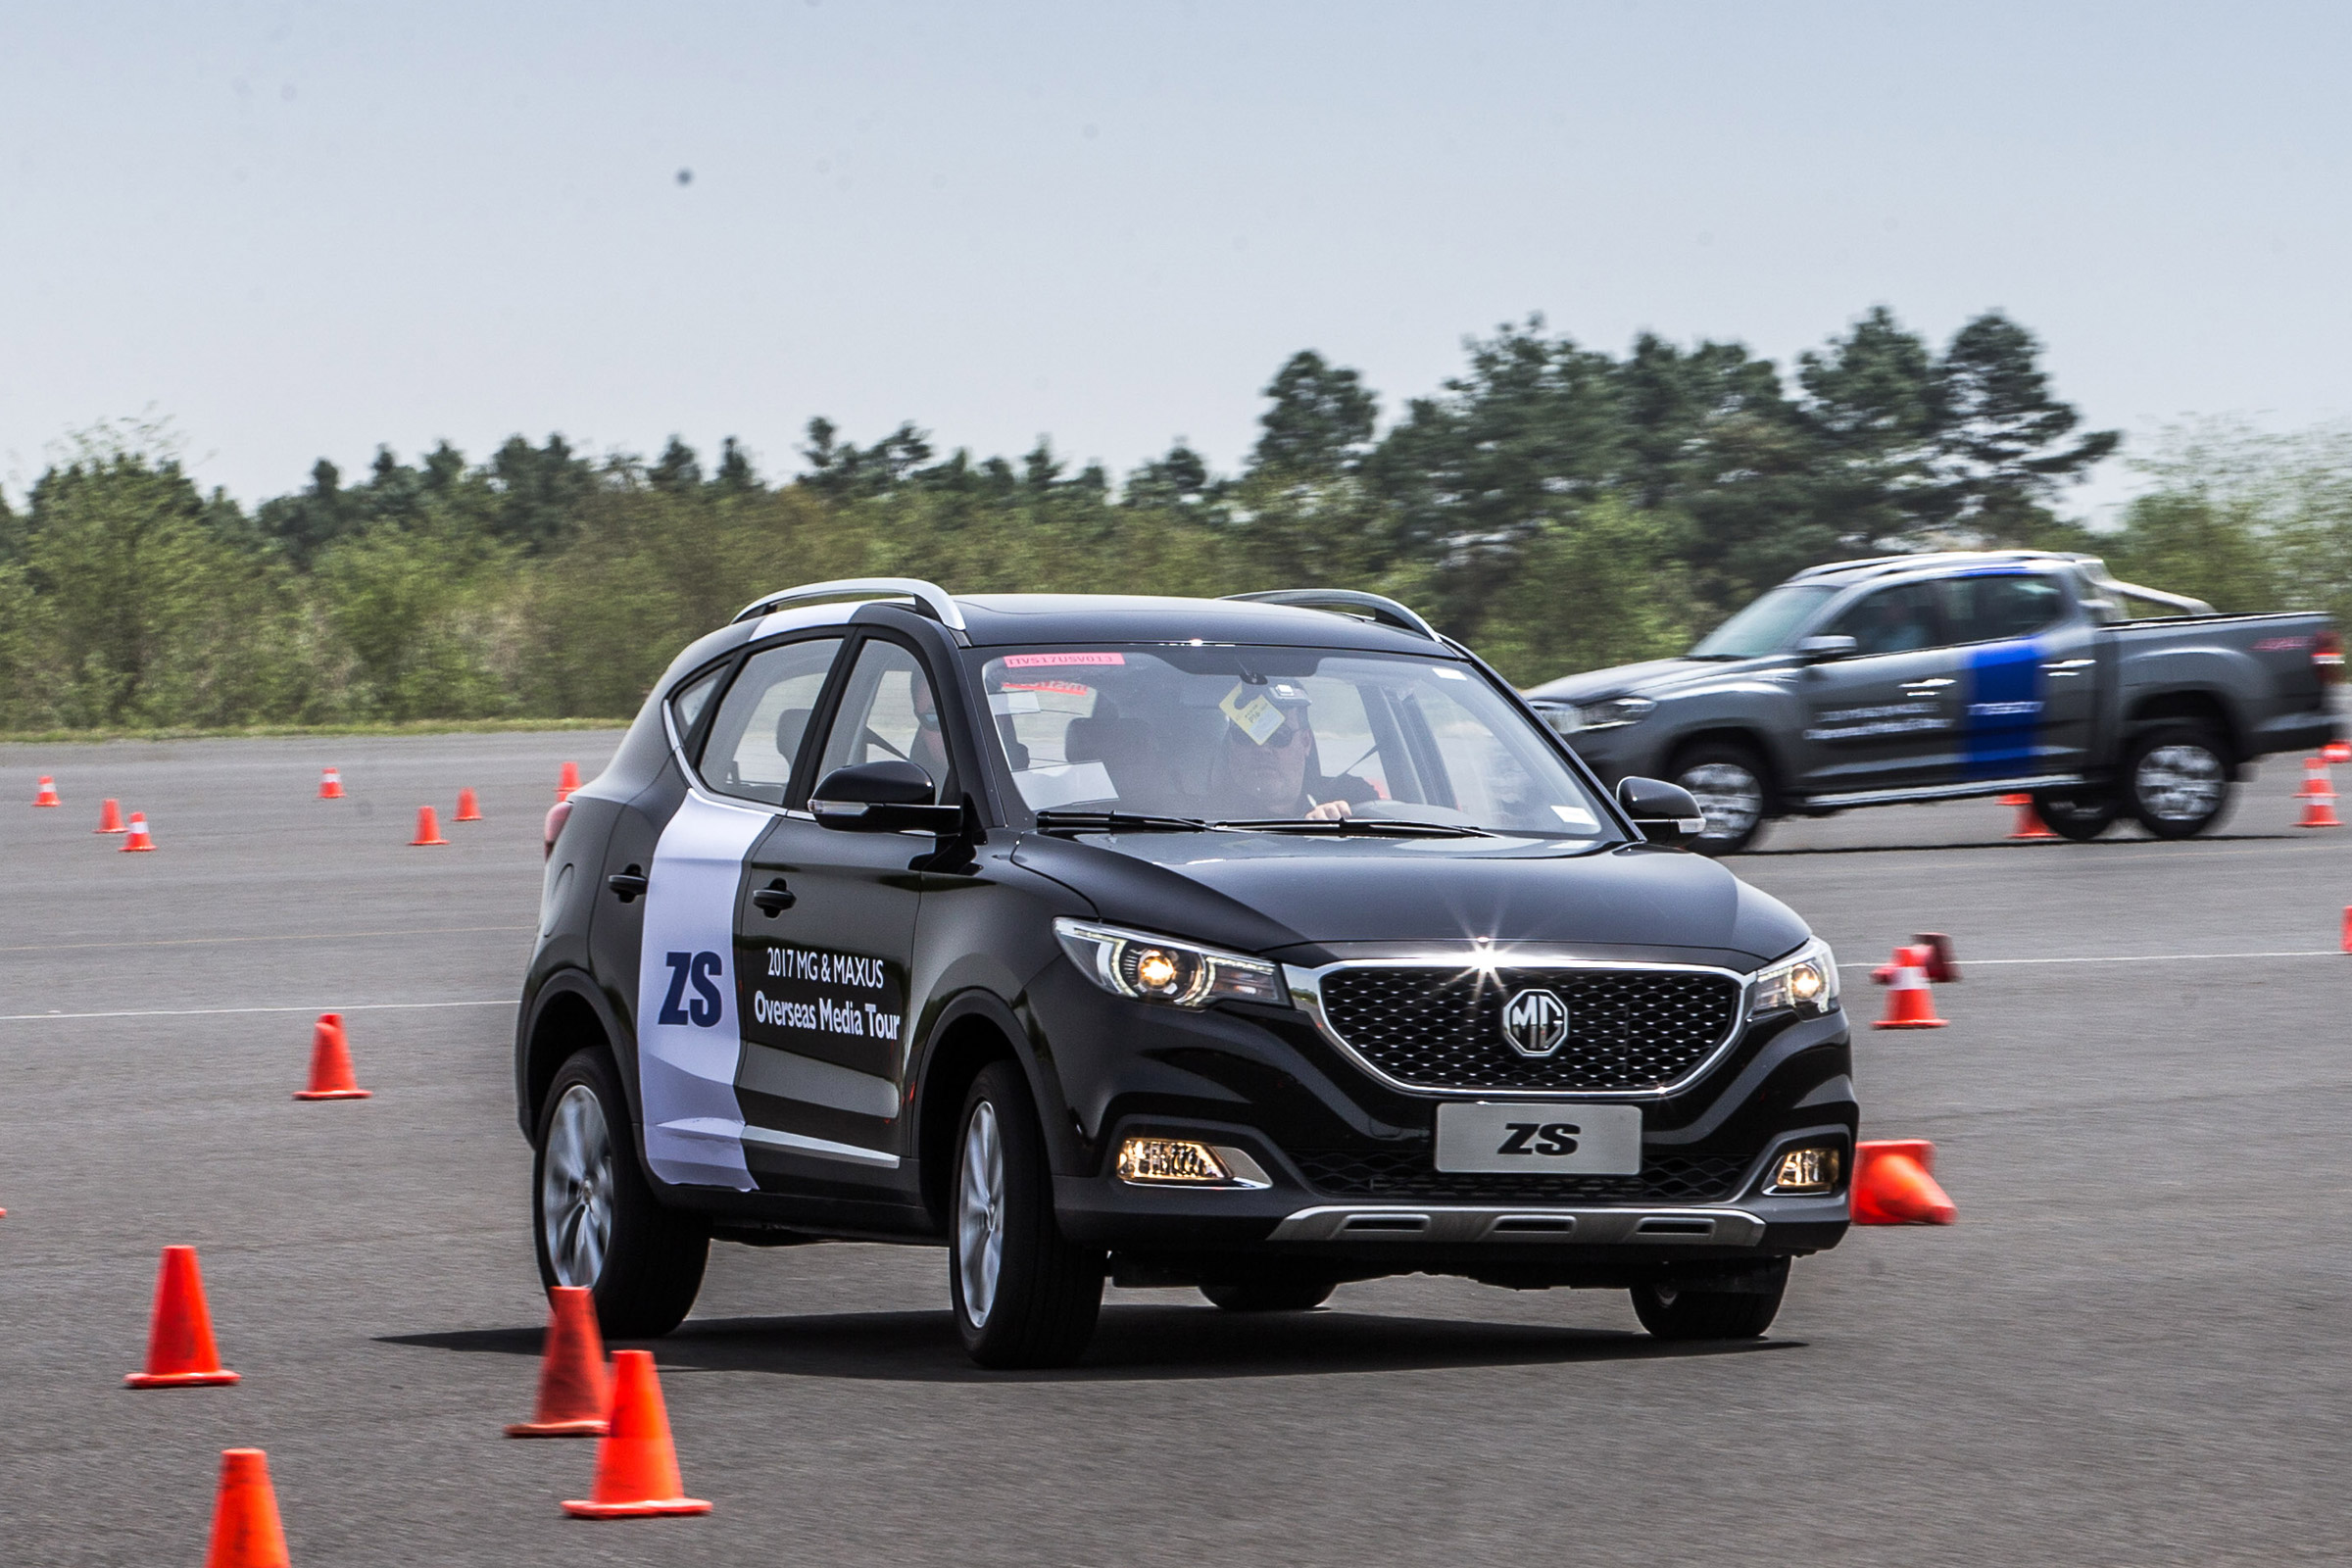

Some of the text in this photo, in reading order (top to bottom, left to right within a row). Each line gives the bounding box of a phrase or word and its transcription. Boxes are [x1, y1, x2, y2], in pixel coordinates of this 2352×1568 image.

[658, 951, 722, 1028] ZS
[767, 947, 884, 989] 2017 MG & MAXUS
[754, 990, 901, 1041] Overseas Media Tour
[1511, 995, 1563, 1050] MG
[1496, 1122, 1581, 1156] ZS
